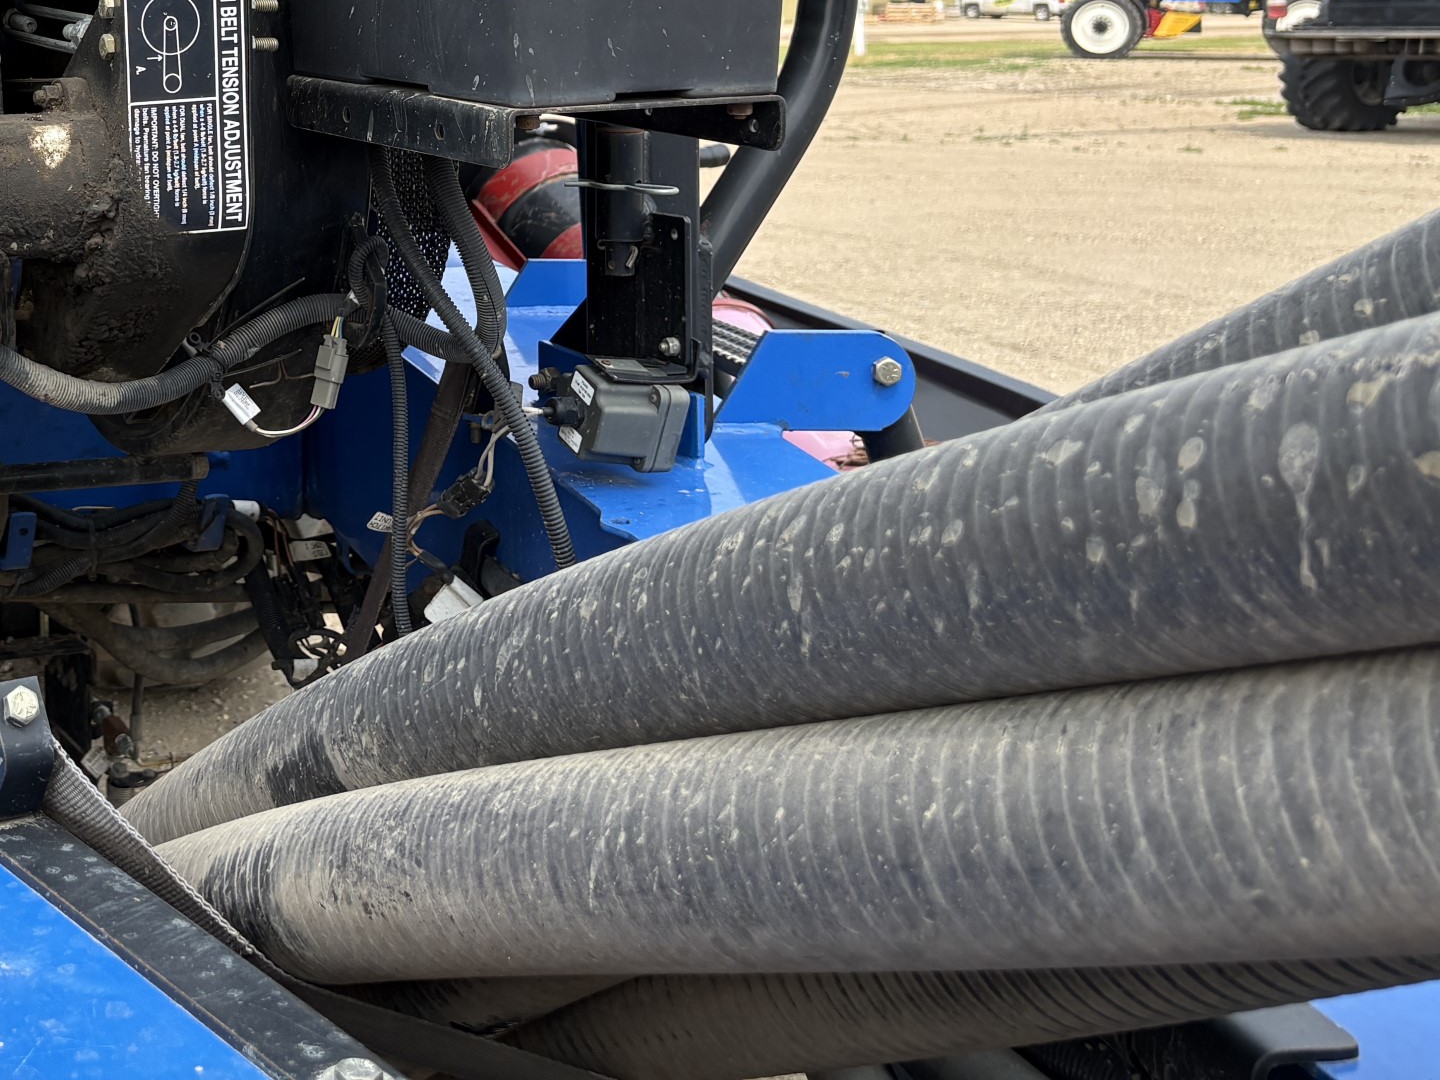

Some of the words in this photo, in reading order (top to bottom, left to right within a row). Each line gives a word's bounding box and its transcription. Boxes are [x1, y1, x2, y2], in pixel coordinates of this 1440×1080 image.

[220, 6, 237, 43] BELT
[222, 47, 240, 115] TENSION
[135, 136, 141, 144] to
[151, 107, 159, 149] IMPORTANT:
[134, 145, 142, 166] hydra
[152, 151, 159, 162] DO
[224, 120, 242, 221] ADJUSTMENT
